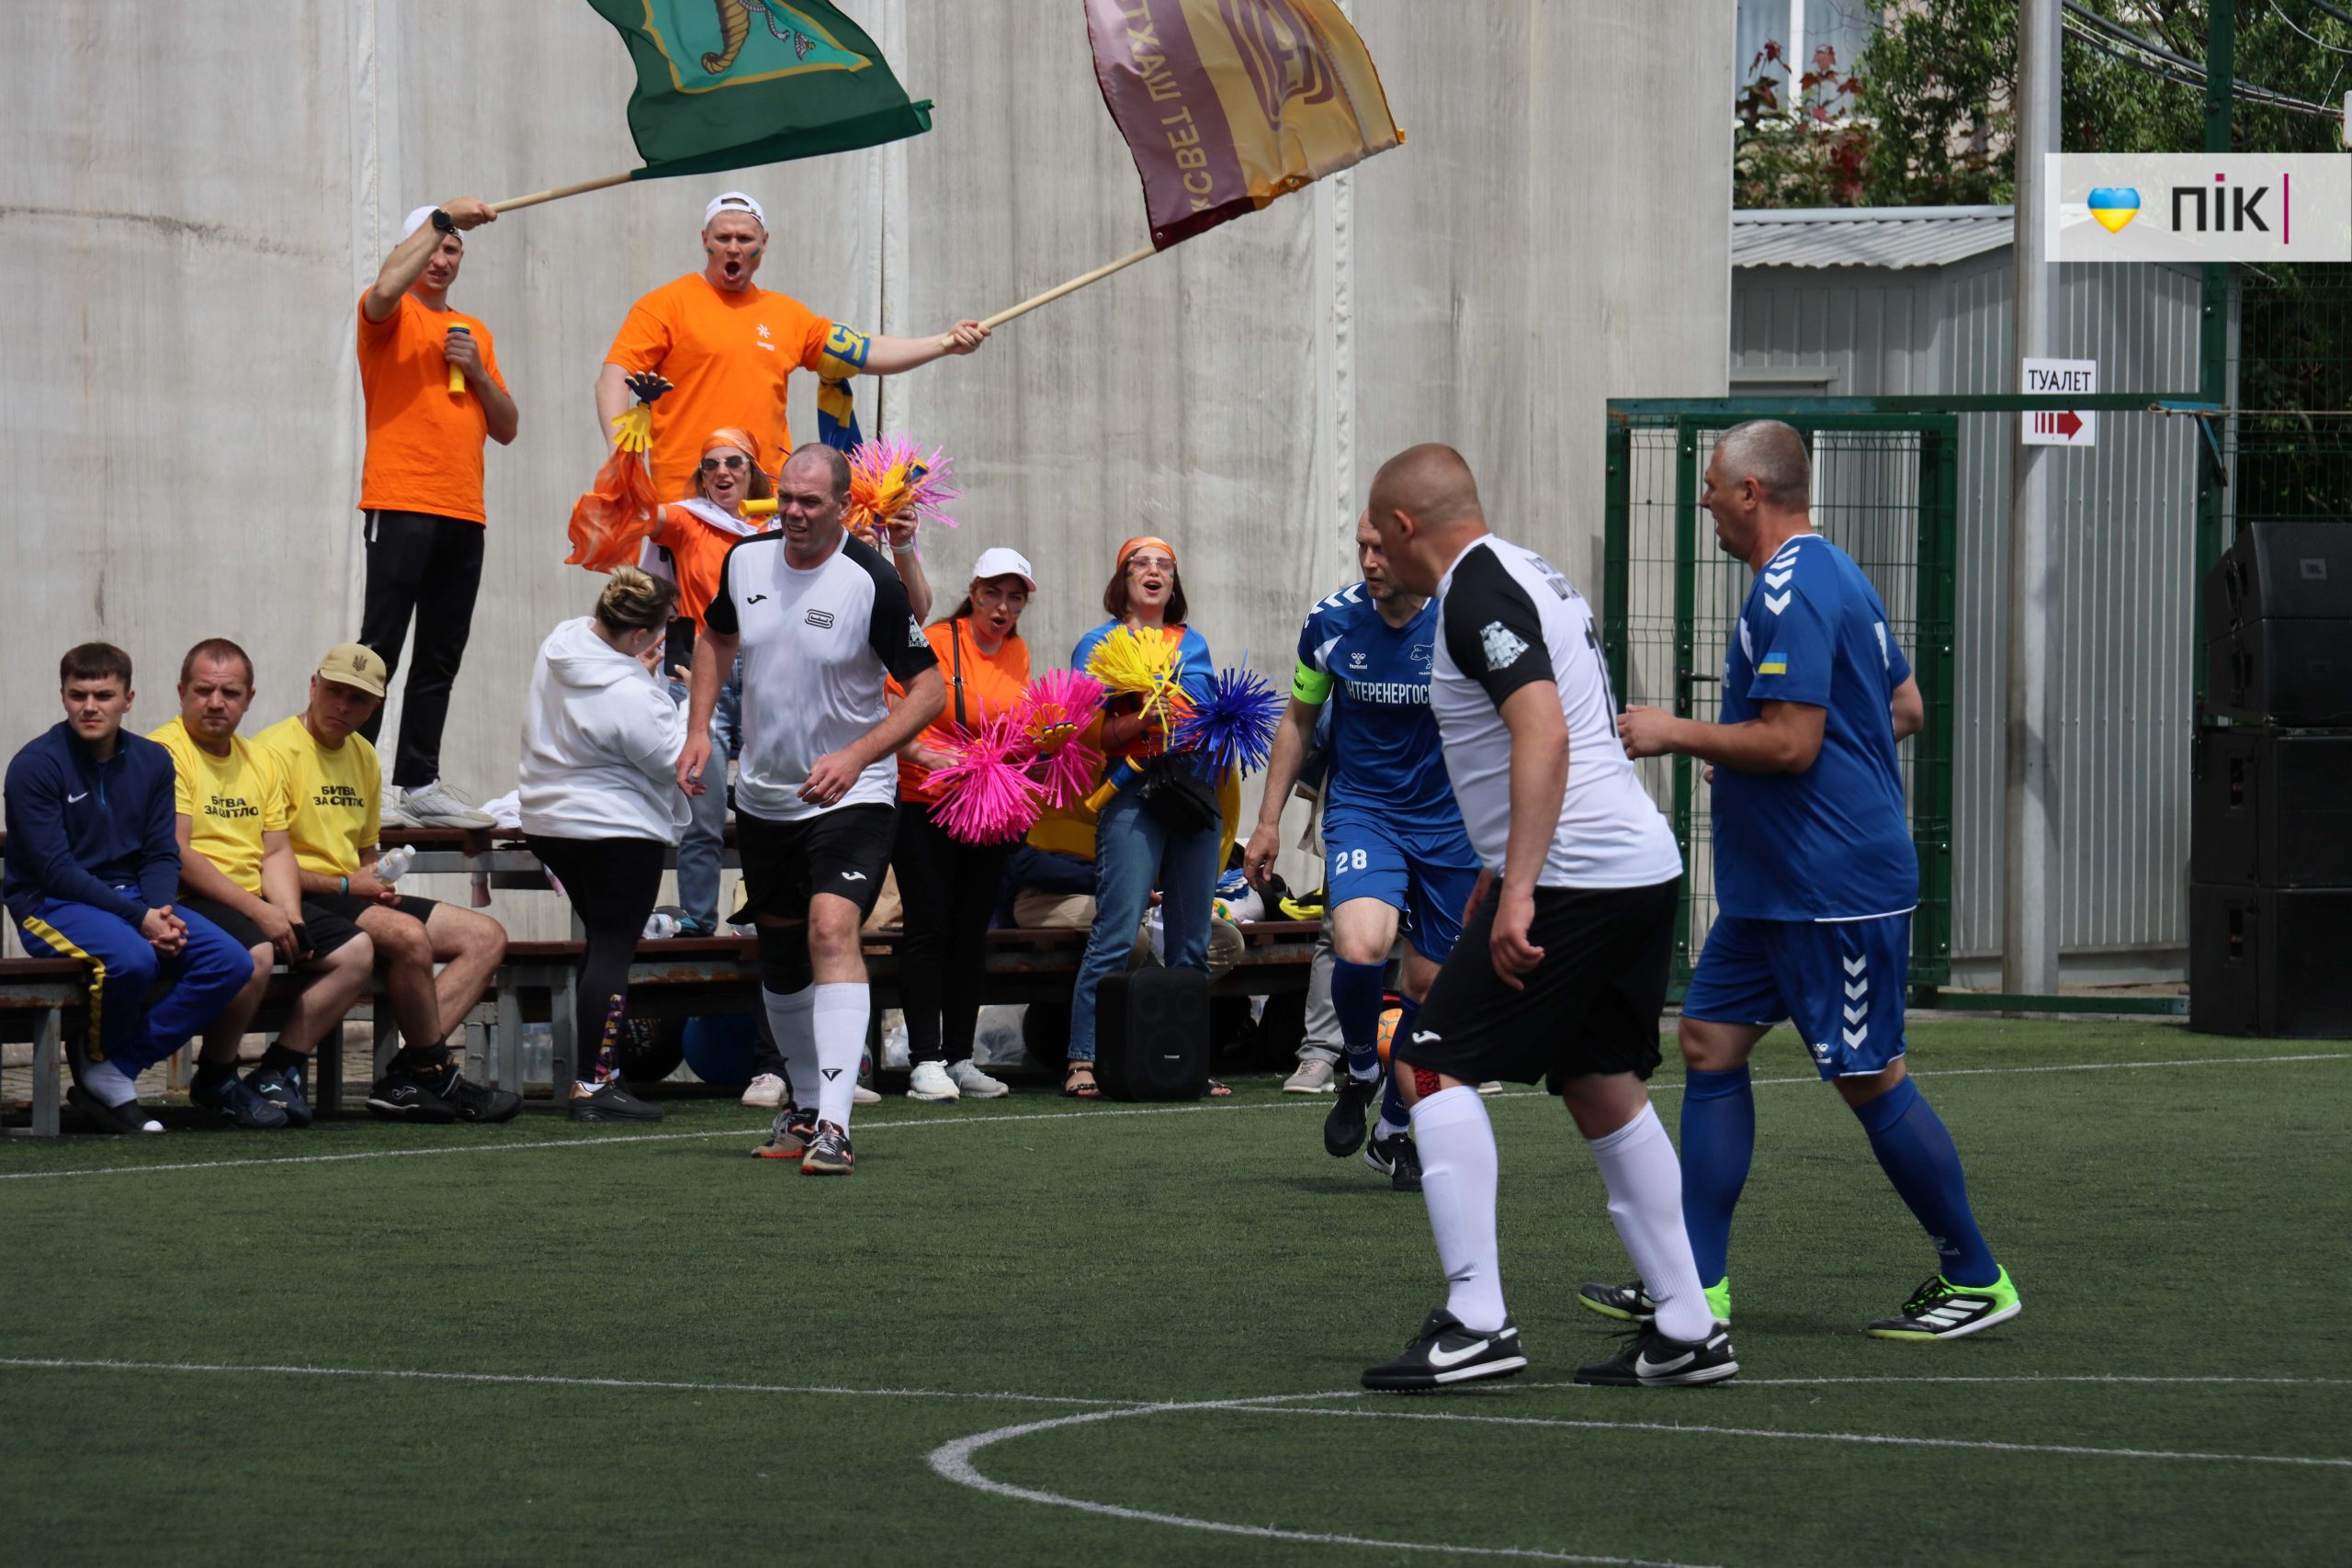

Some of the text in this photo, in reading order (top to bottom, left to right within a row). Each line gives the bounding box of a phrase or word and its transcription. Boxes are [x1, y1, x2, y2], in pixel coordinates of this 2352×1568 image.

[2028, 369, 2092, 392] ТУАЛЕТ
[313, 795, 329, 806] ЗА
[1335, 849, 1368, 876] 28
